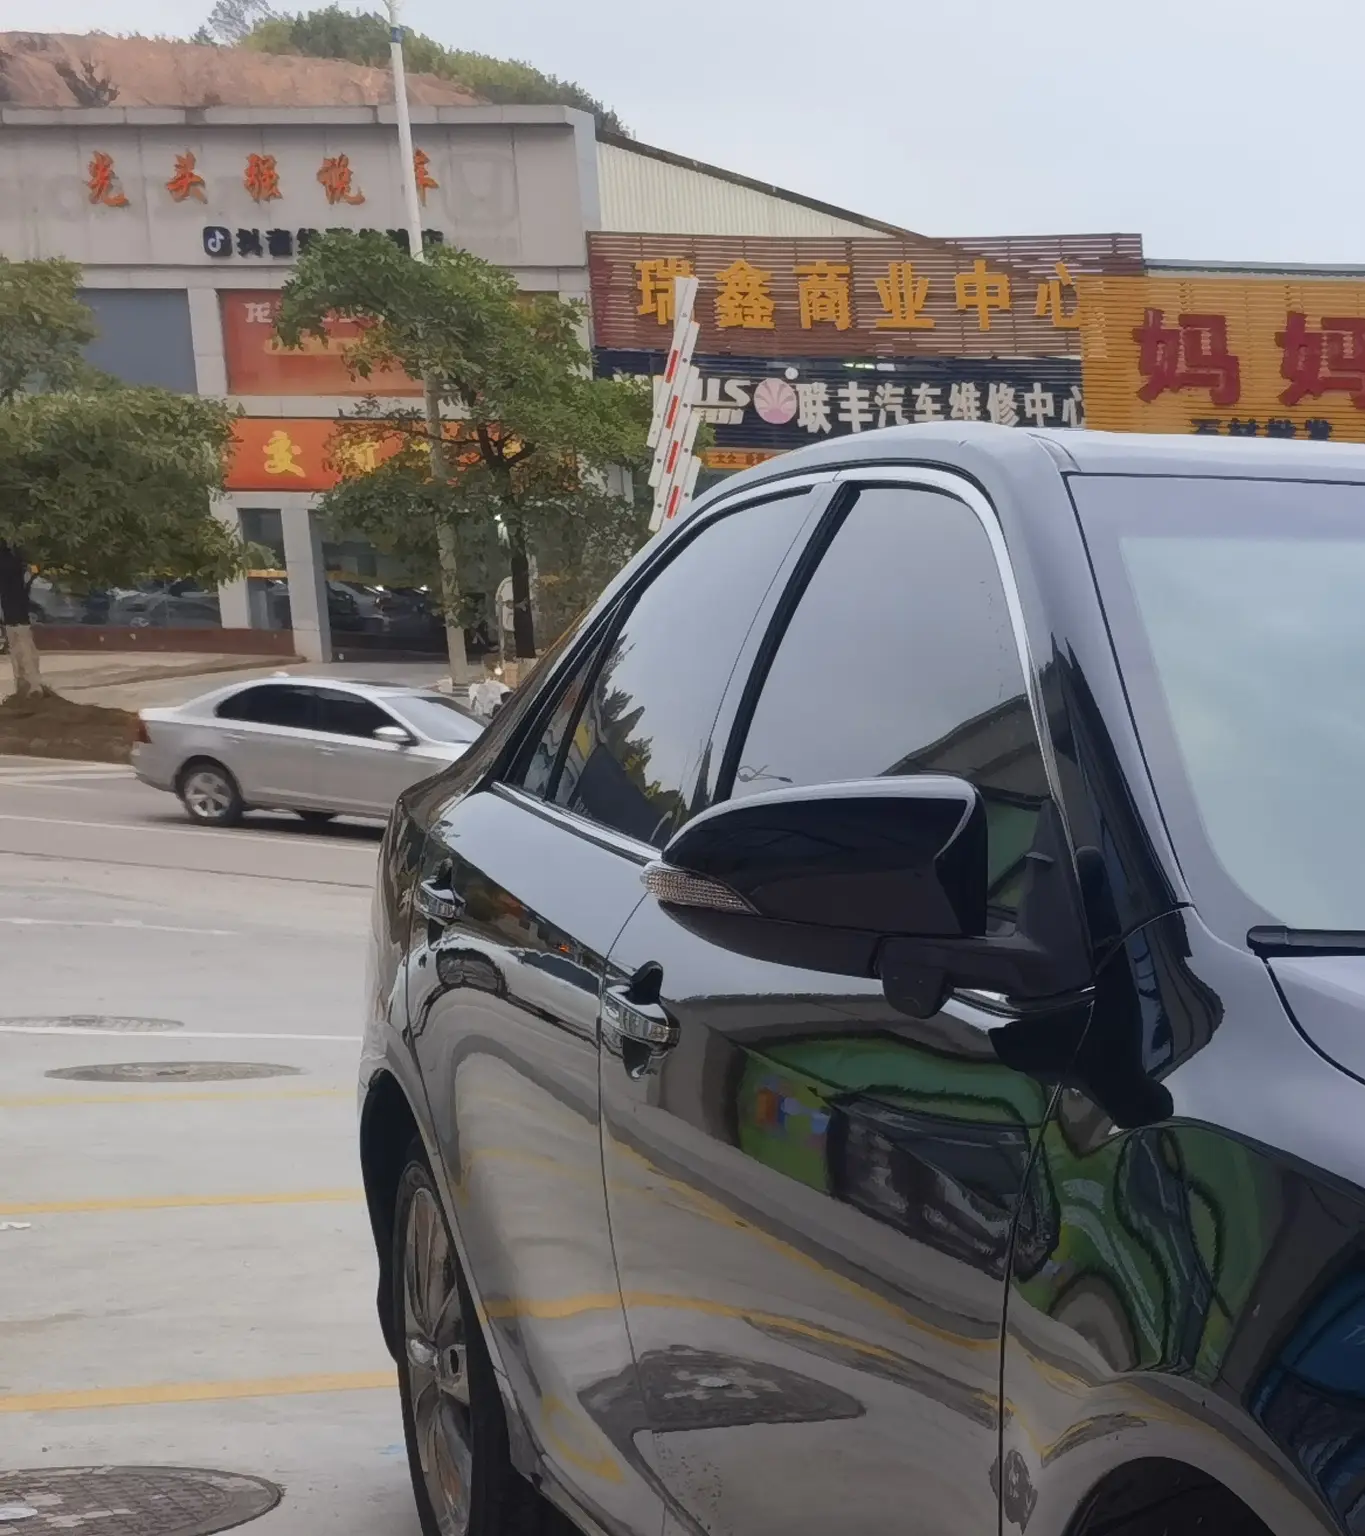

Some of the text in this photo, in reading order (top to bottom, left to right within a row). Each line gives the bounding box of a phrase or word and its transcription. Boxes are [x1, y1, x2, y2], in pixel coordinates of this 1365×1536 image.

[634, 256, 1081, 332] 瑞鑫商业中心
[795, 381, 1086, 434] 联丰汽车维修中心
